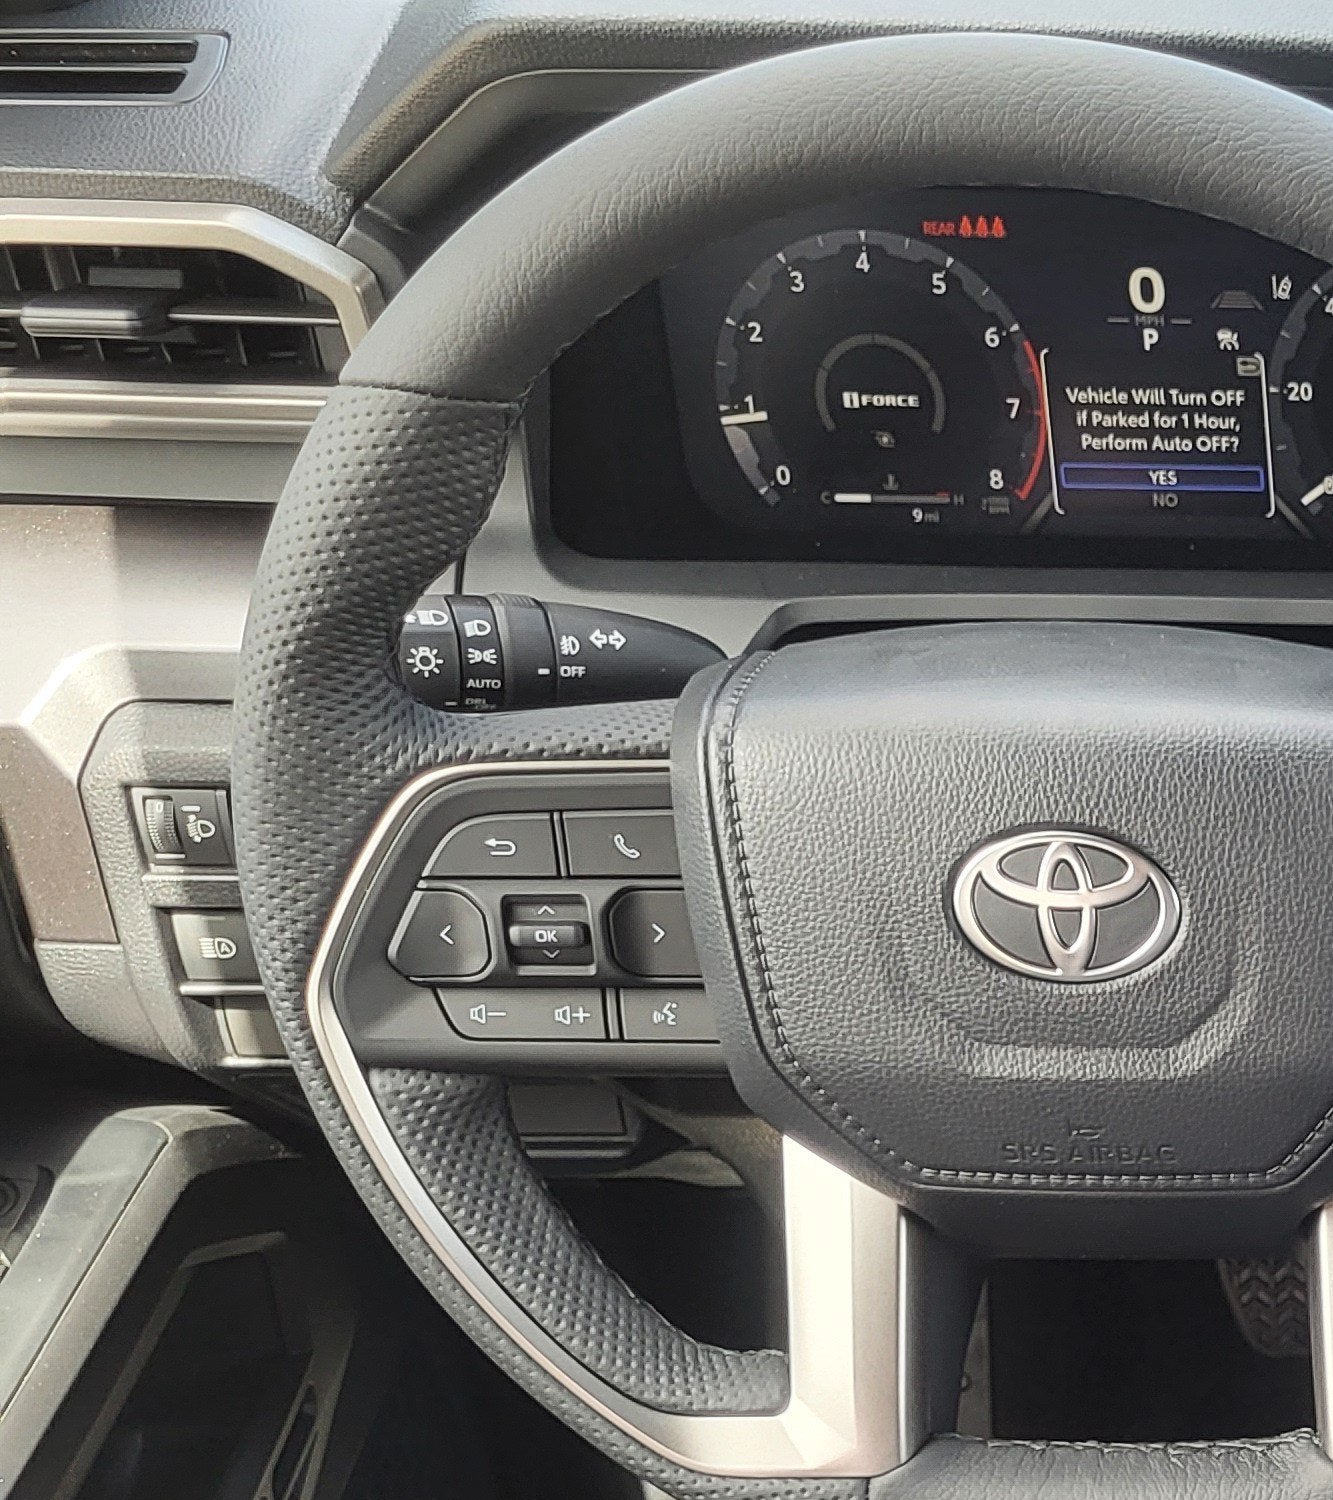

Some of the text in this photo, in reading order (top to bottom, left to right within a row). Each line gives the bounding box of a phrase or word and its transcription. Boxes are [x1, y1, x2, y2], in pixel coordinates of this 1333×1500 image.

[855, 253, 871, 274] 4
[789, 271, 805, 293] 3
[931, 273, 947, 295] 5
[1128, 266, 1166, 314] 0
[747, 322, 764, 344] 2
[984, 326, 1001, 348] 6
[1142, 328, 1159, 351] P
[1065, 386, 1246, 407] Vehicle Will Turn OFF
[1287, 381, 1313, 402] 20
[1005, 397, 1021, 420] 7
[1091, 410, 1150, 429] Parked
[1153, 410, 1178, 429] for
[1181, 412, 1190, 429] 1
[1193, 412, 1241, 432] Hour,
[1081, 432, 1240, 453] Perform Auto OFF?
[775, 465, 792, 487] 0
[989, 468, 1005, 491] 8
[1149, 470, 1178, 486] YES
[1153, 492, 1179, 508] NO
[911, 507, 924, 523] 9
[560, 665, 586, 679] OFF
[466, 678, 501, 690] AUTO
[534, 929, 558, 943] OK
[1001, 1143, 1179, 1165] SRS AIRBAG
